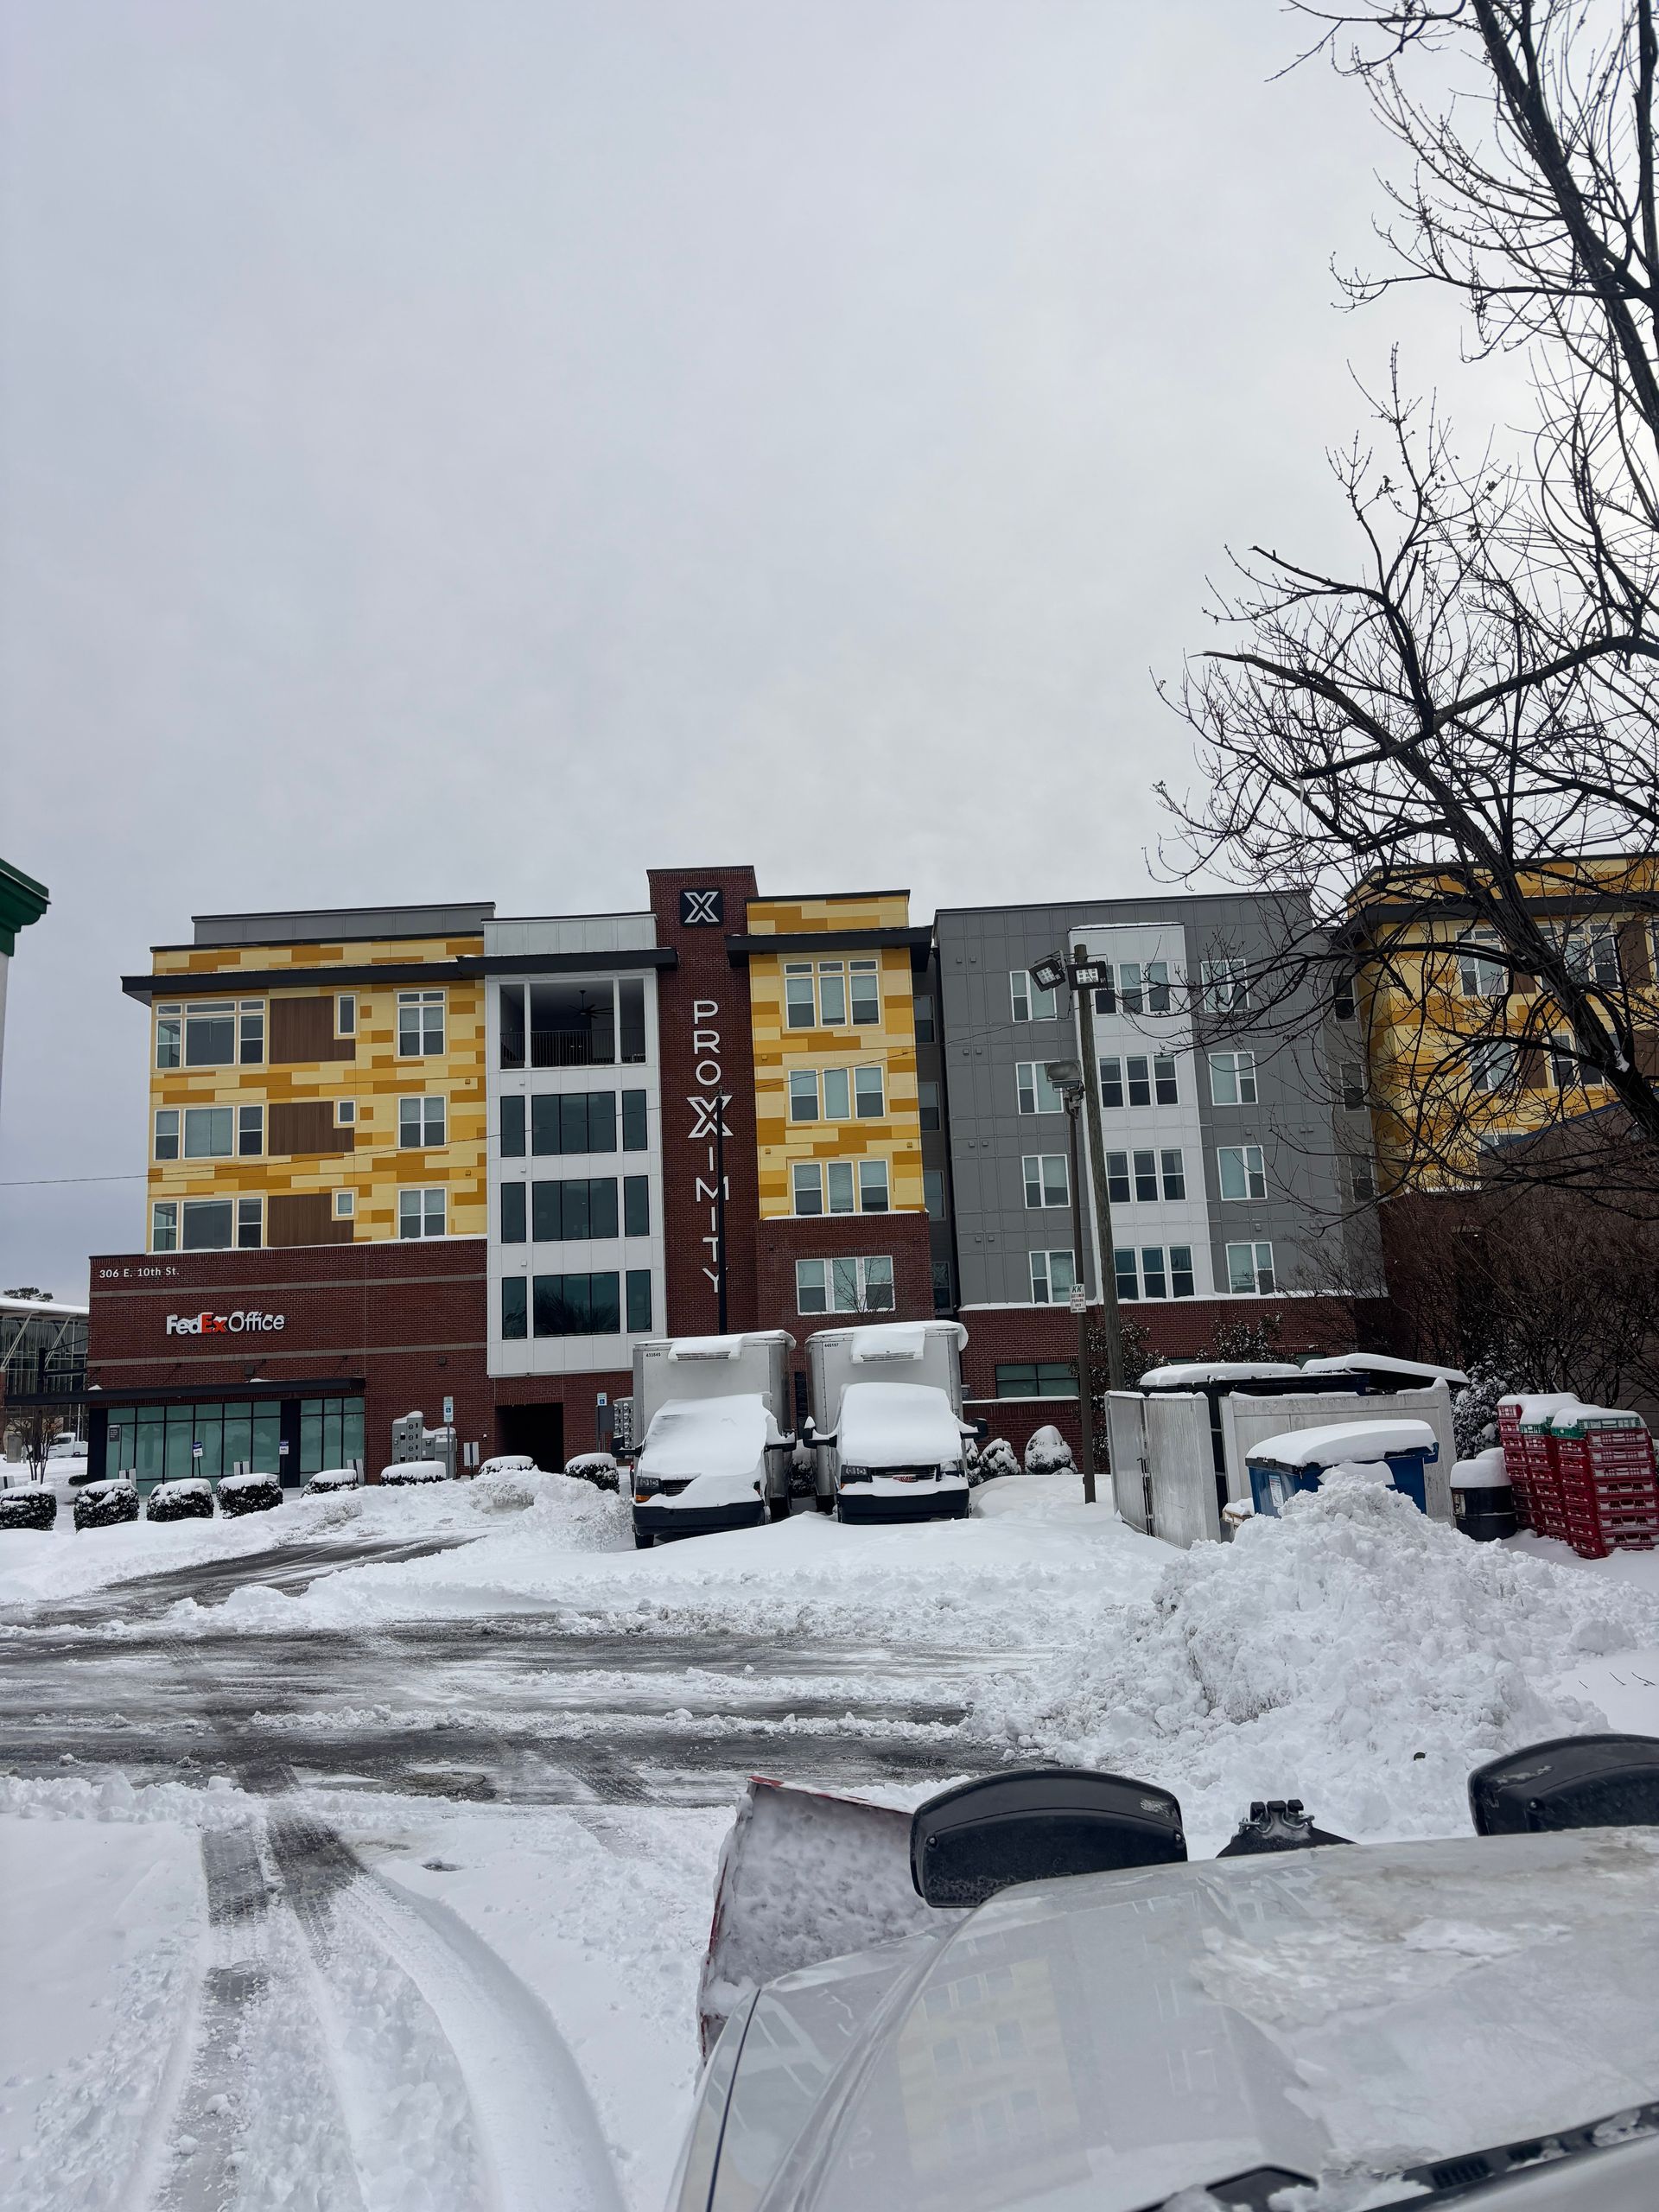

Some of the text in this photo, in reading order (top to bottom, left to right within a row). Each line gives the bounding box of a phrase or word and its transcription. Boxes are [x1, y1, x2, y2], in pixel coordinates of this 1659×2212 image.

[687, 1000, 734, 1294] PROXIMITY
[99, 1267, 180, 1278] 306 E. 10th St.
[166, 1312, 285, 1335] FedEx Office
